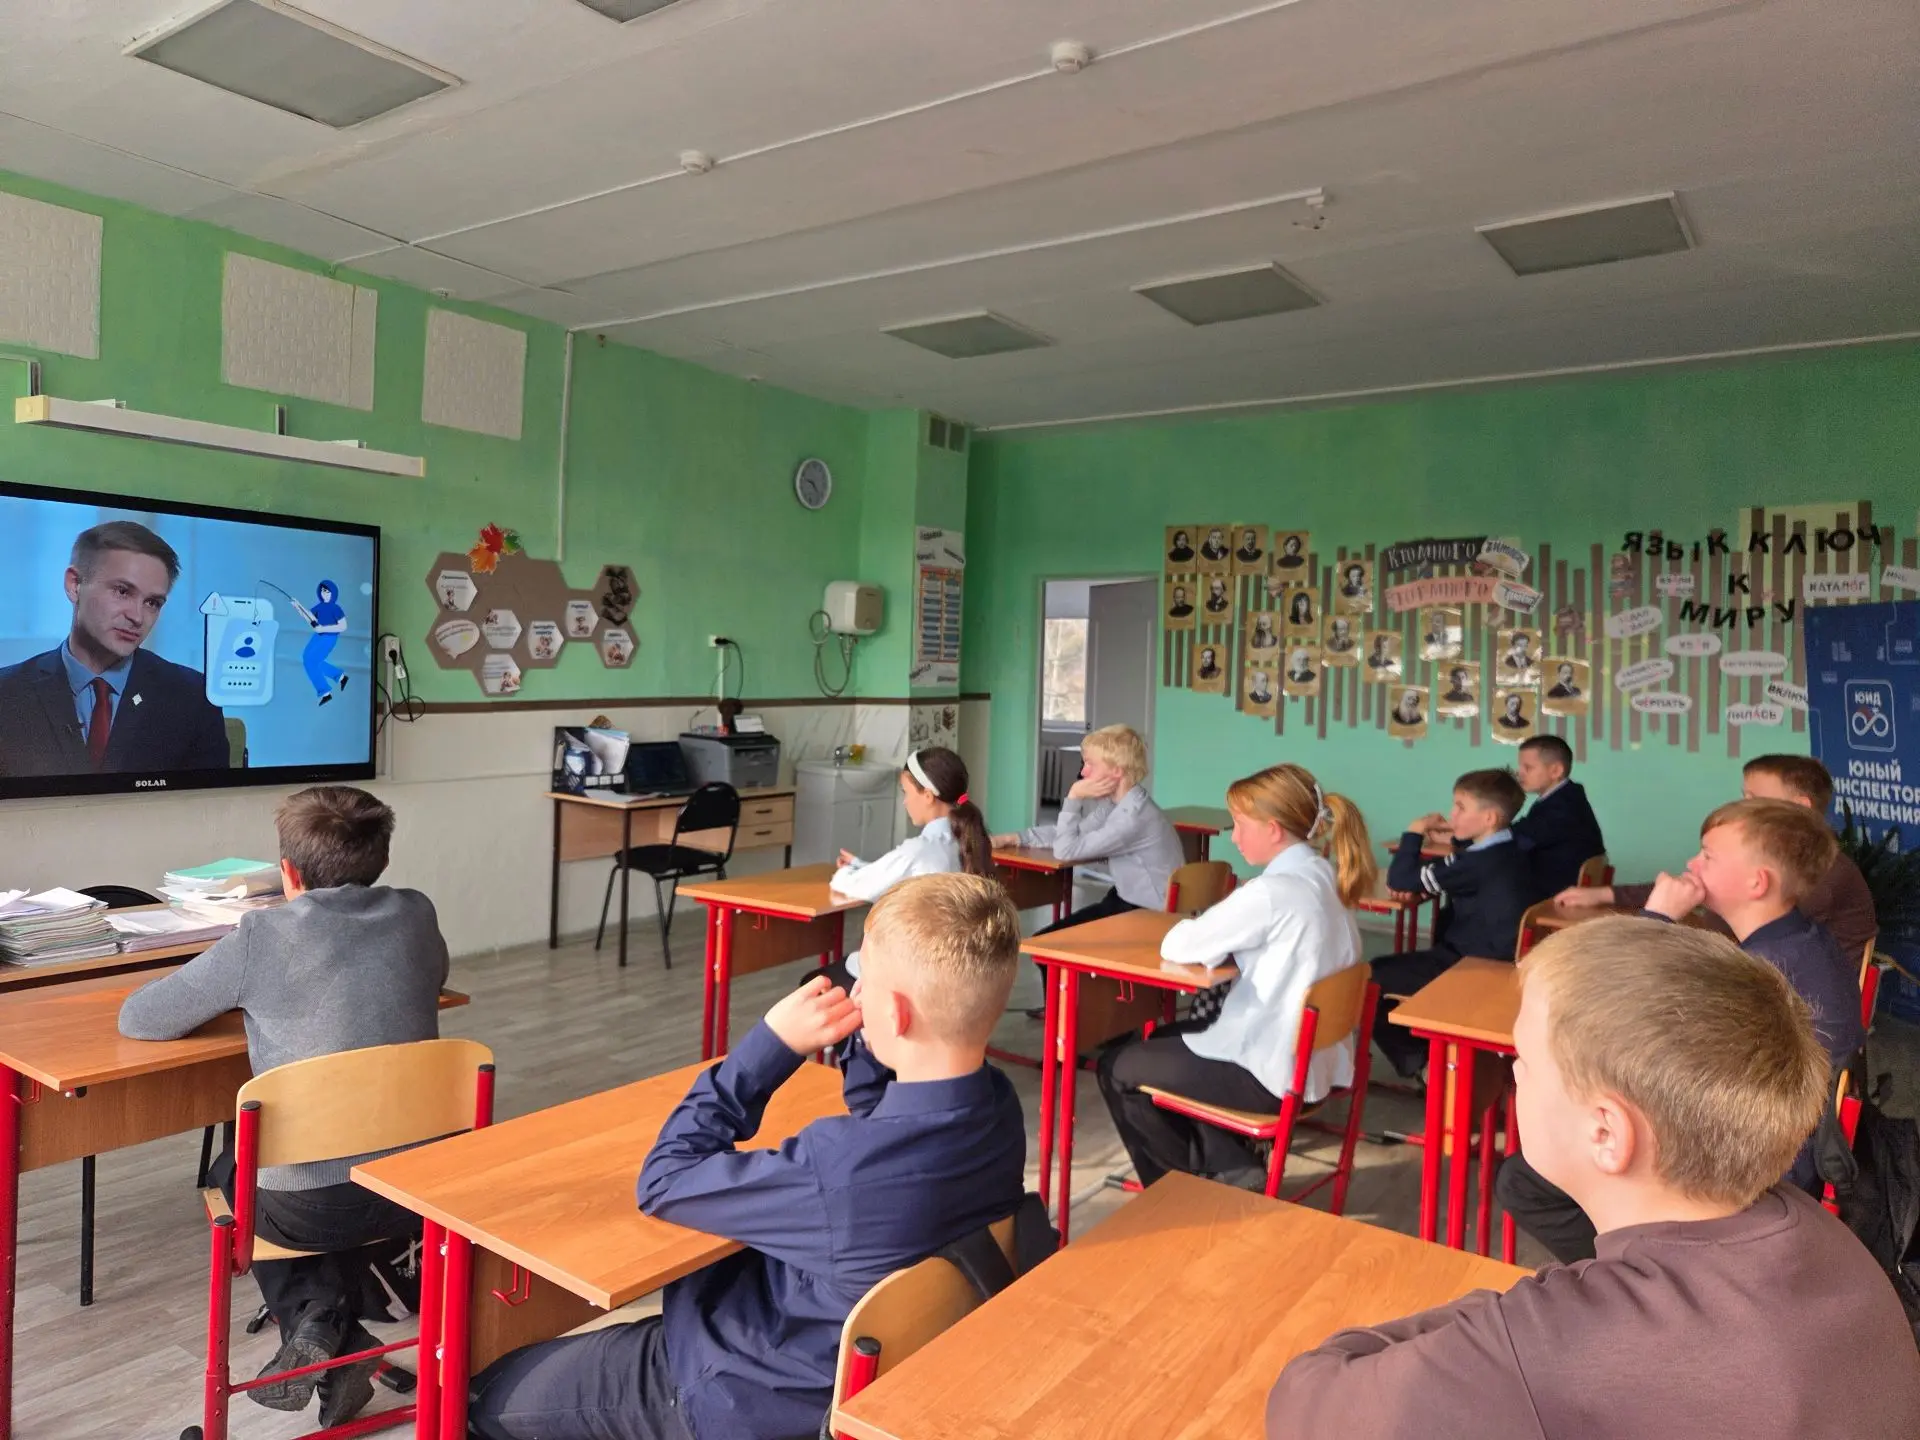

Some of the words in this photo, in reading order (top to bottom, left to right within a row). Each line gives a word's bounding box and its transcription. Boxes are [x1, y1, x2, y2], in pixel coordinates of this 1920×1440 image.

[1622, 529, 1729, 561] ЯЗЫК
[1748, 524, 1882, 555] КЛЮЧ
[1728, 573, 1750, 595] К
[1679, 598, 1796, 629] МИРУ
[1854, 691, 1881, 708] ЮИД
[1848, 758, 1902, 782] ЮНЫЙ
[135, 779, 167, 787] SOLAR
